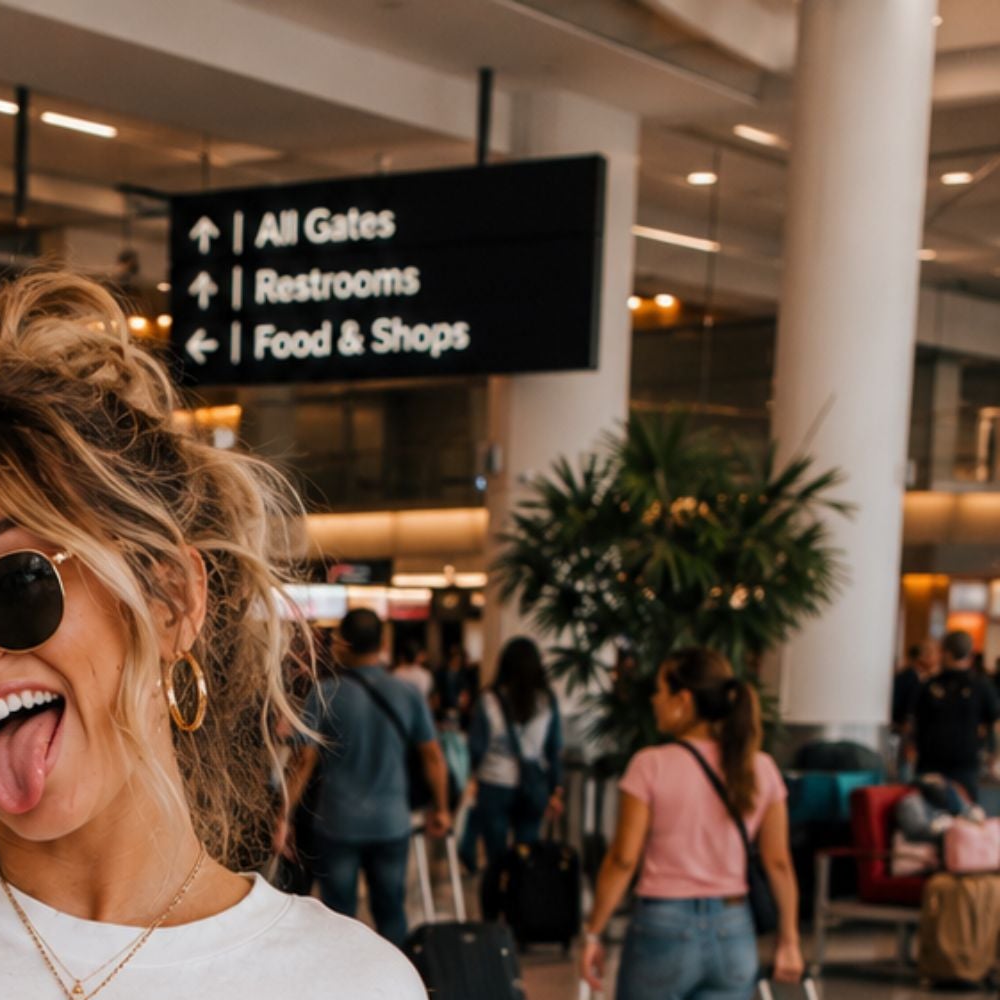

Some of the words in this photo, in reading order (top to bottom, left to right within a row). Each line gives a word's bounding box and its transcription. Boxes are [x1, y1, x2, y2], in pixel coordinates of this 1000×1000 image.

[254, 210, 299, 248] All
[303, 207, 396, 244] Gates
[254, 266, 421, 305] Restrooms
[253, 320, 333, 360] Food
[337, 319, 365, 356] &
[371, 316, 470, 358] Shops
